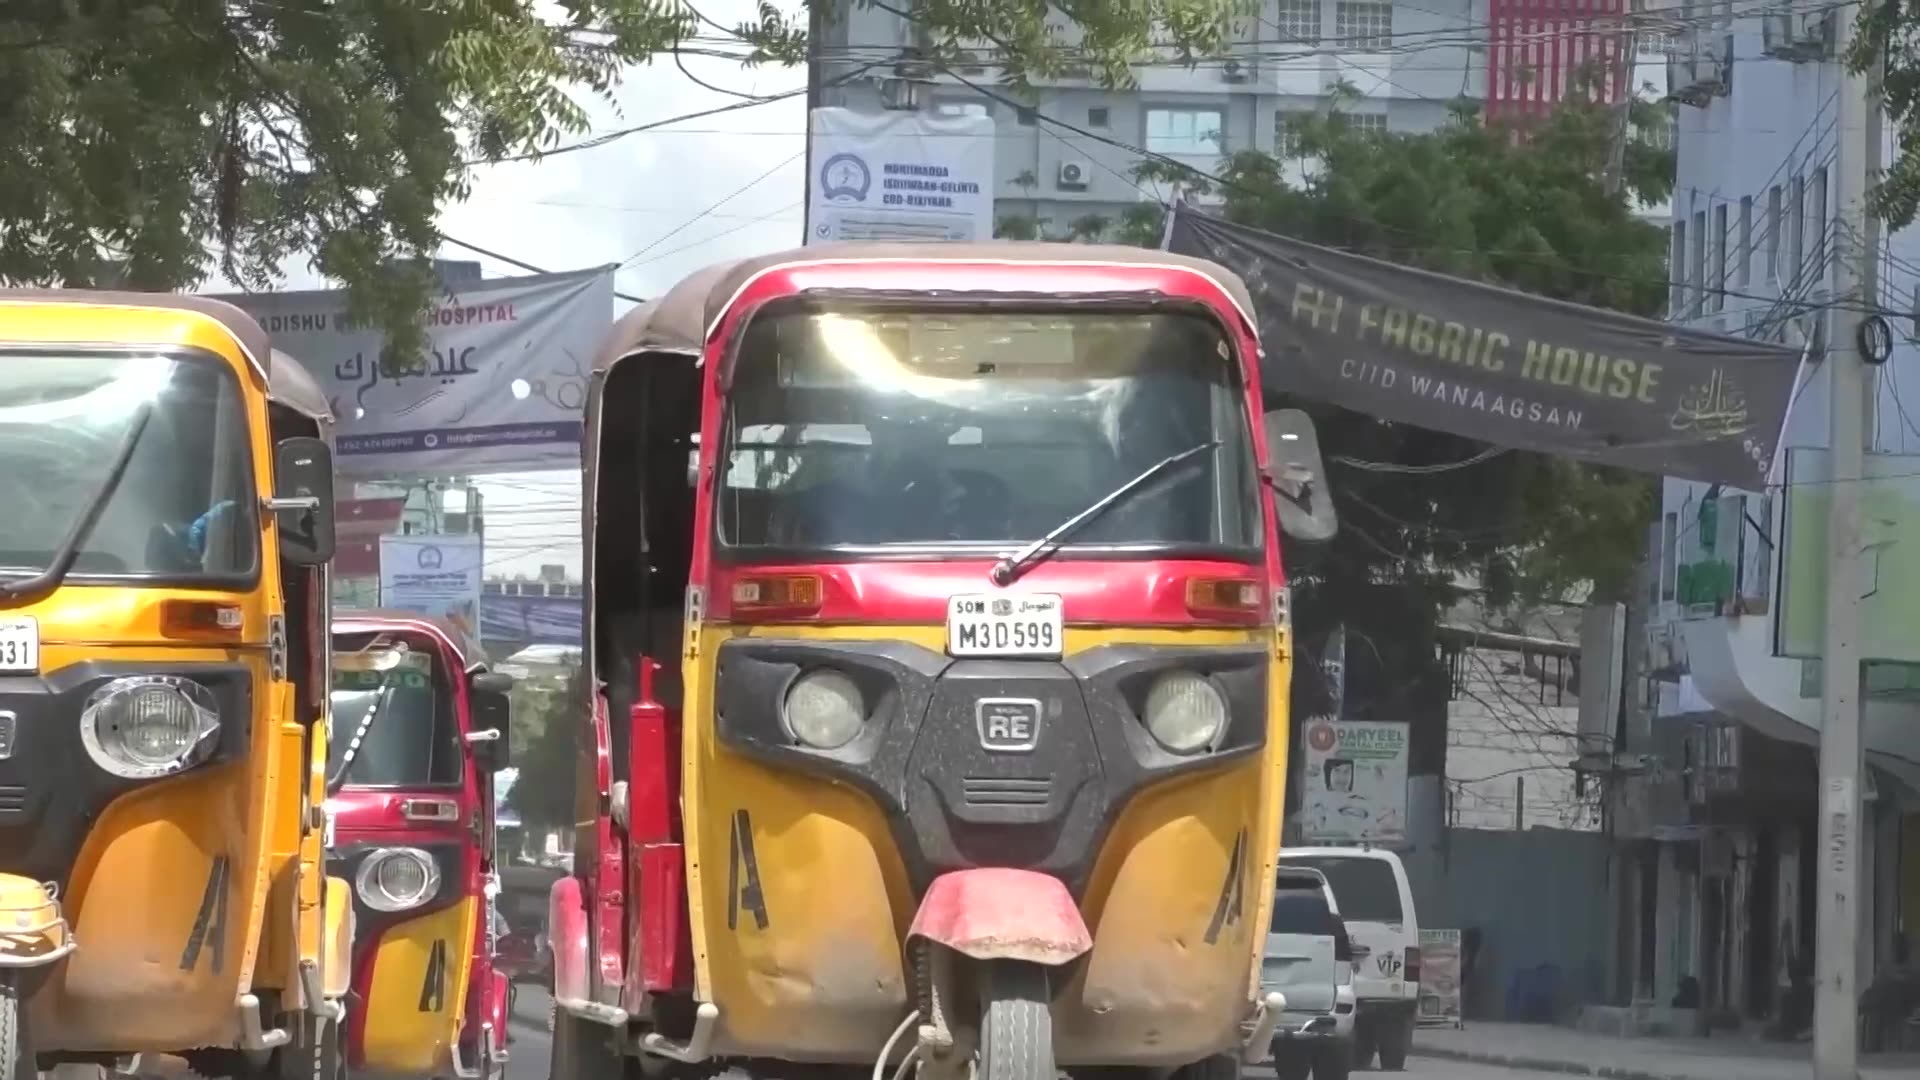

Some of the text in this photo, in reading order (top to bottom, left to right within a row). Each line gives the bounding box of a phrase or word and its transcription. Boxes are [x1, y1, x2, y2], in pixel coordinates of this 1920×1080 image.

[428, 303, 518, 327] HOSPITAL
[1357, 303, 1510, 372] FABRIC
[1521, 339, 1663, 404] HOUSE
[1341, 358, 1583, 430] CIID WANAAGSAN
[956, 601, 985, 614] SOM
[989, 715, 1030, 739] RE
[1337, 728, 1405, 742] DARYEEL
[1376, 959, 1402, 977] VIP
